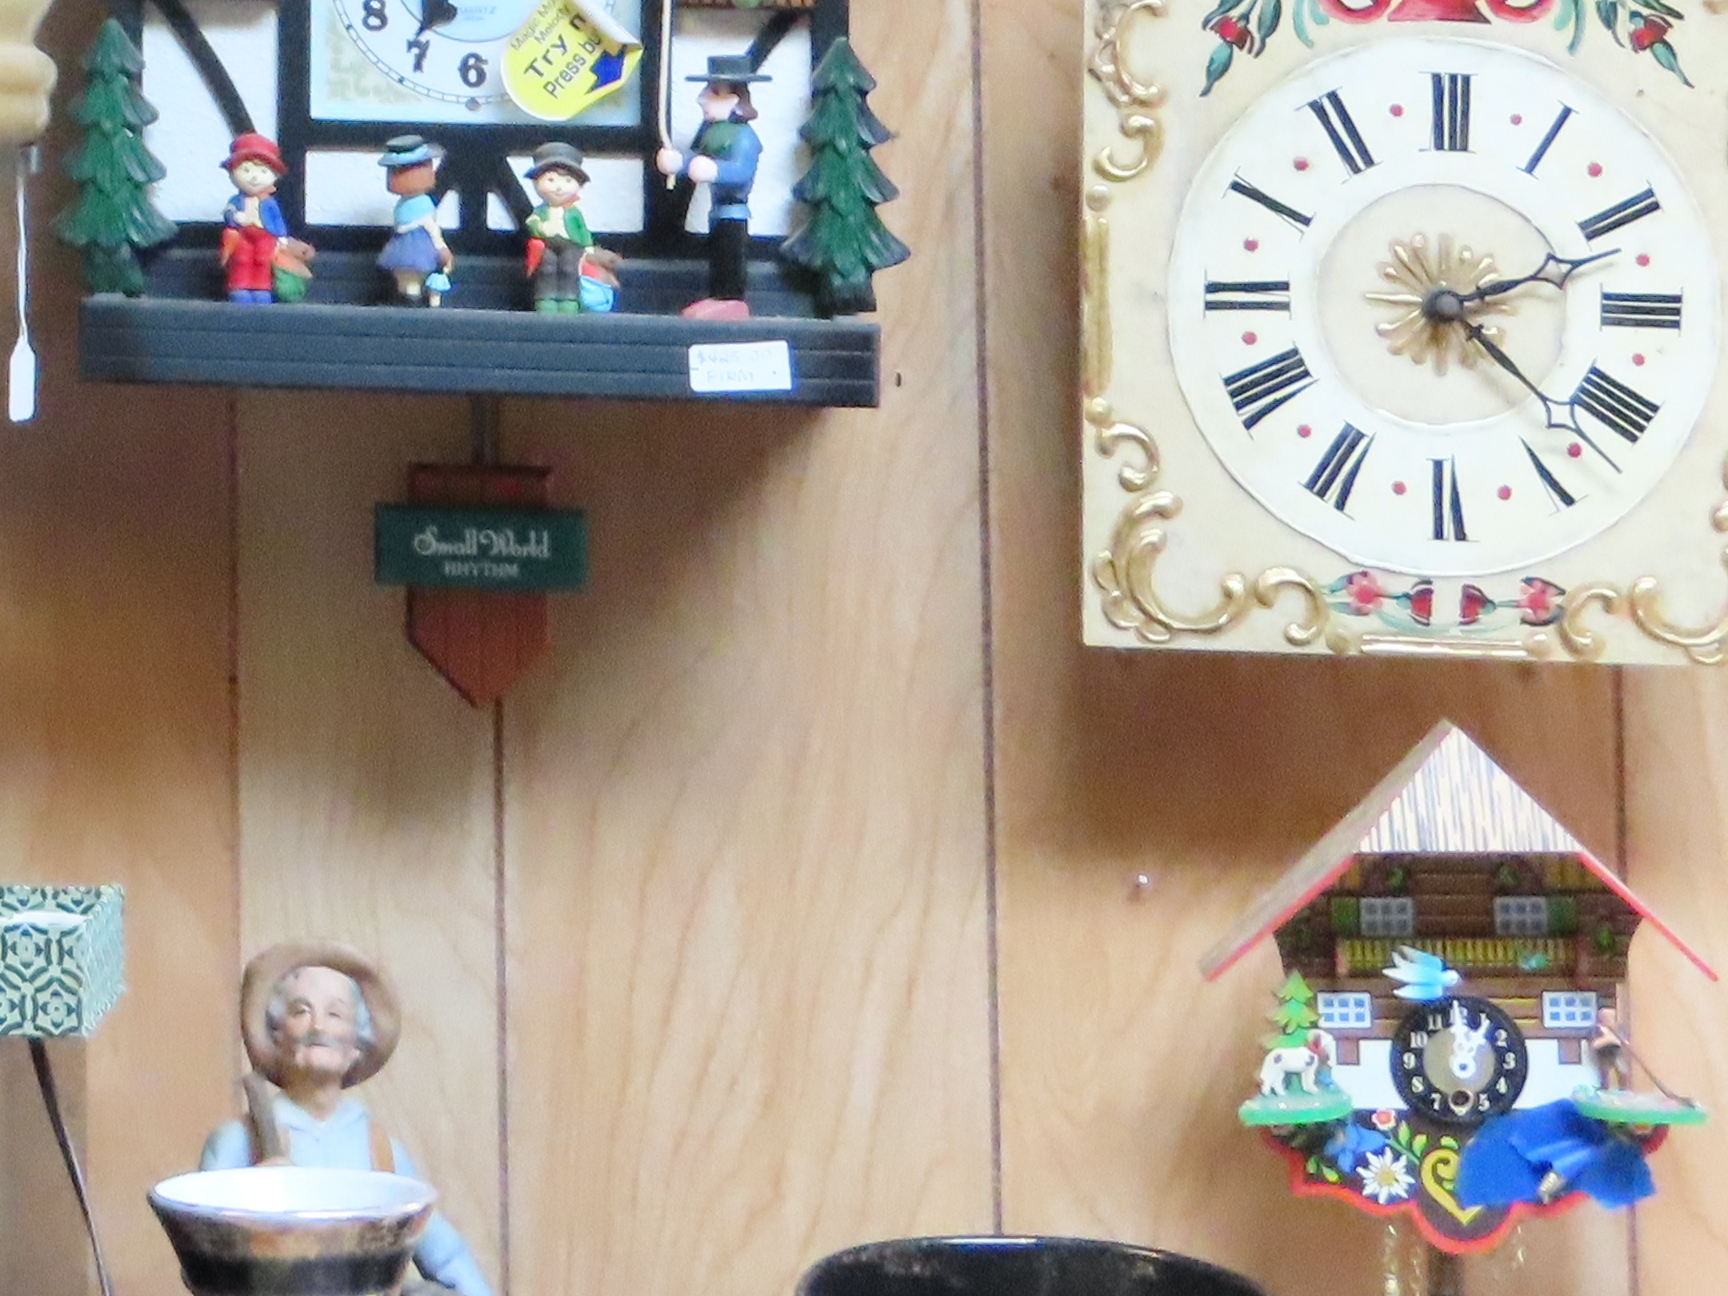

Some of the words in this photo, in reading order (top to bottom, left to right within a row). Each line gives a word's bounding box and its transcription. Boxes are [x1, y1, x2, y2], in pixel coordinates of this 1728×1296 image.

[458, 52, 489, 88] 6
[524, 34, 567, 78] Try
[543, 54, 586, 100] Press
[1296, 86, 1383, 183] XI
[1418, 71, 1477, 153] XII
[1517, 102, 1578, 180] I
[1576, 180, 1665, 250] II
[1600, 283, 1683, 336] III
[1298, 420, 1376, 520] VII
[1519, 436, 1588, 514] V
[1426, 454, 1479, 542] VI
[414, 524, 477, 555] Small
[1403, 1052, 1415, 1069] 9
[1410, 1031, 1428, 1048] 10
[1495, 1029, 1508, 1047] 2
[1503, 1052, 1516, 1069] 3
[1430, 1093, 1442, 1110] 7
[1478, 1093, 1490, 1111] 5
